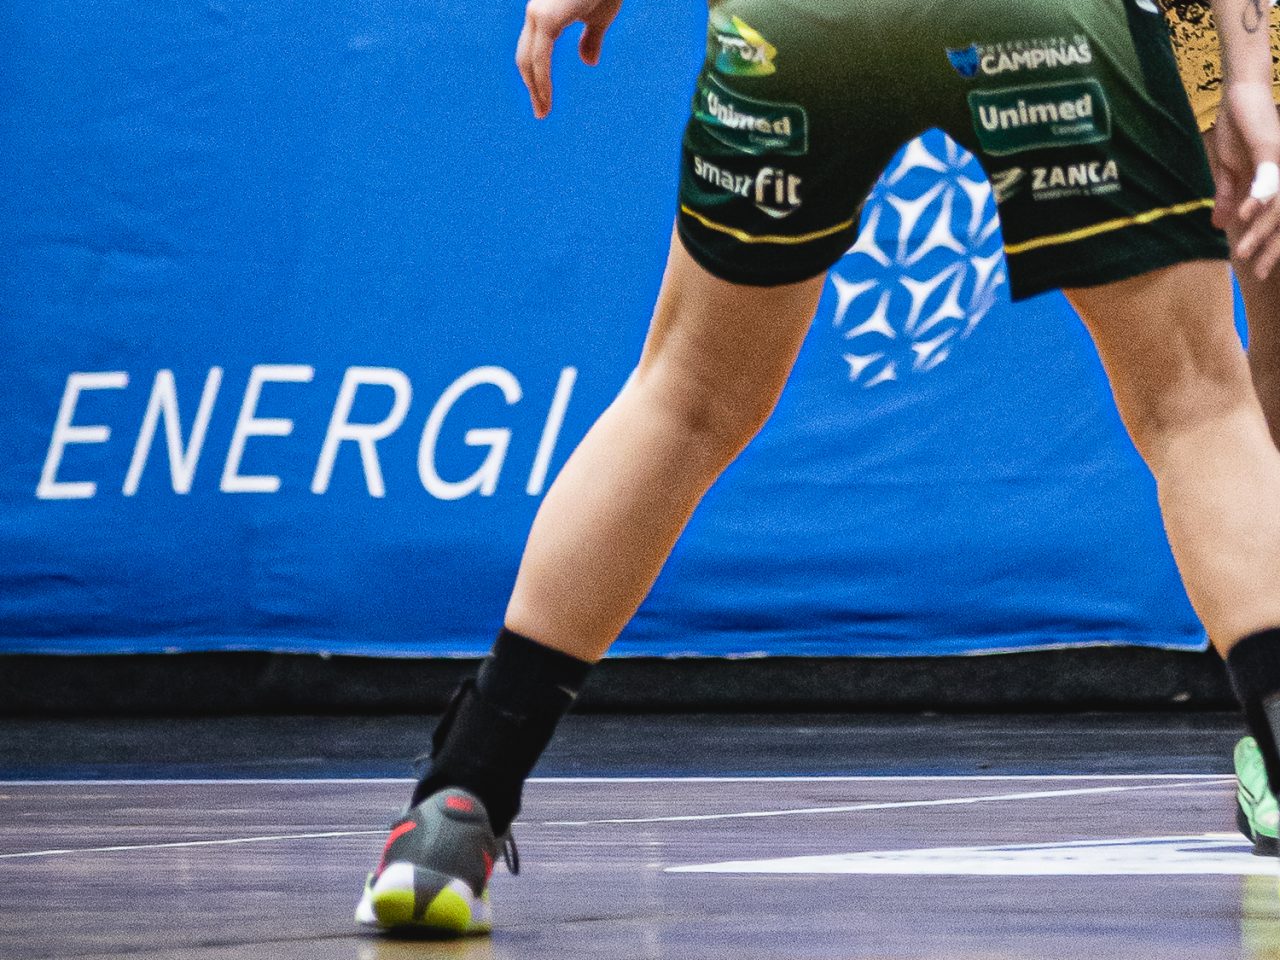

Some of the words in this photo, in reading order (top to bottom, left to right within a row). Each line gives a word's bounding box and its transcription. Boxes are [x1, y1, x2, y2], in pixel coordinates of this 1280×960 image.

[981, 43, 1093, 75] CAMPINAS
[707, 91, 792, 137] Unimed
[979, 93, 1093, 132] Unimed
[755, 167, 802, 207] fit
[1032, 159, 1119, 190] ZANCA
[36, 365, 578, 500] ENERGI
